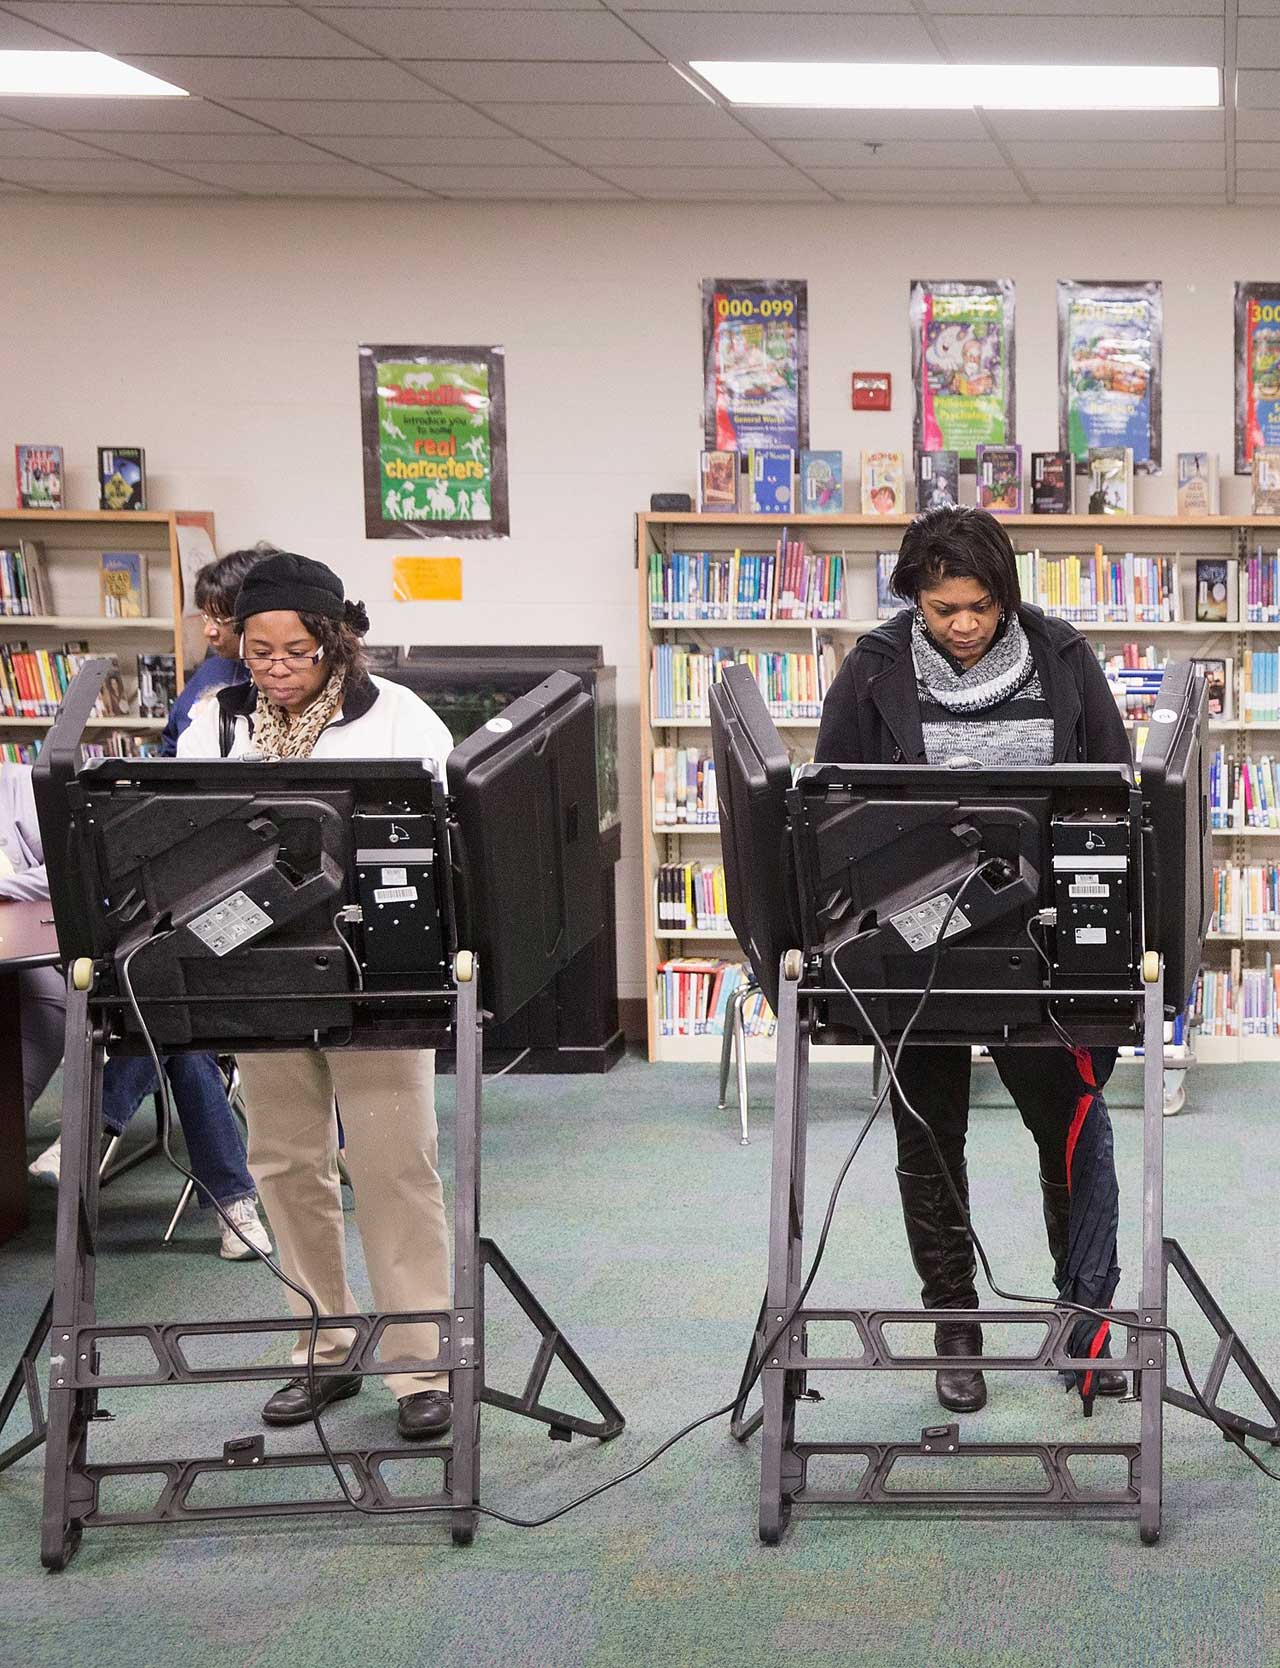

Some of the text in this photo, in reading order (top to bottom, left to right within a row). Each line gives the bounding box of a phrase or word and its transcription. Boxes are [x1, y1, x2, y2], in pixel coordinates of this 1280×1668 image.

[718, 299, 794, 317] 000-099
[415, 435, 456, 457] real
[385, 457, 484, 479] characters
